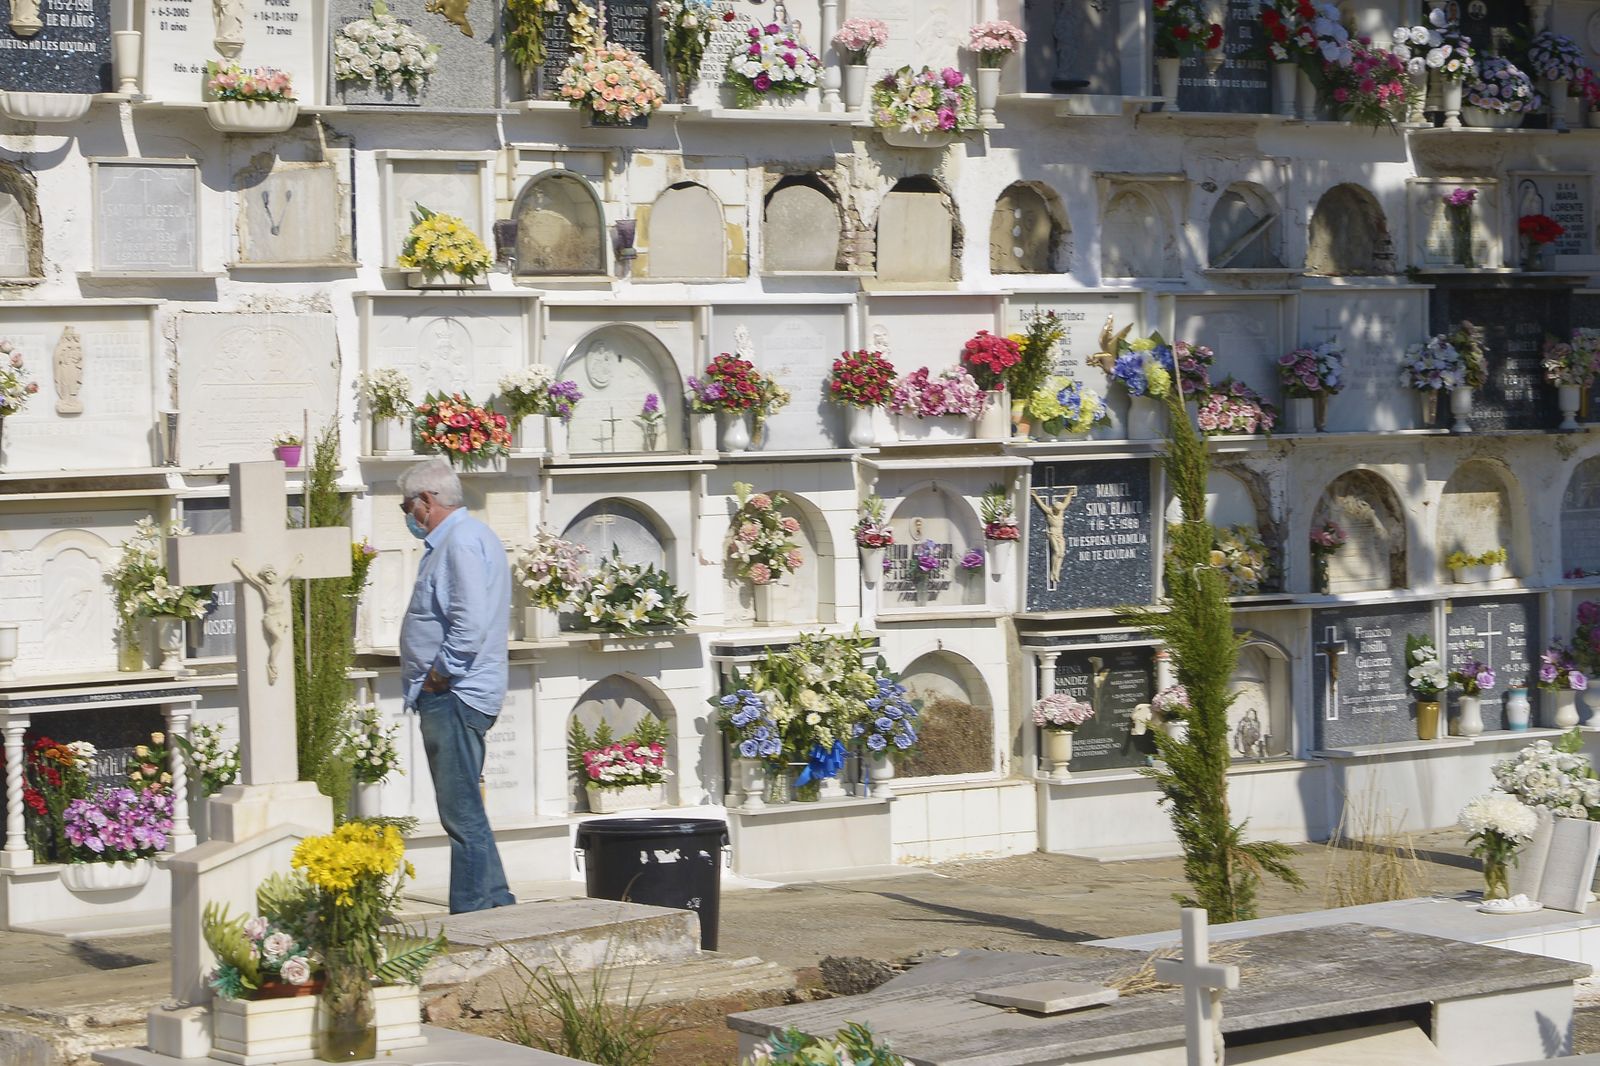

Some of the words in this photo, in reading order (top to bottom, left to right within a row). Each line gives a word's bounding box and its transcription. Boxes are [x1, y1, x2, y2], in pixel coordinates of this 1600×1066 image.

[46, 13, 59, 27] DE
[71, 12, 95, 28] AÑOS
[612, 17, 645, 29] GOMEZ
[170, 23, 187, 32] años
[29, 40, 40, 50] NO
[41, 41, 59, 51] LES
[60, 41, 97, 52] OLVIDAN
[190, 64, 199, 74] de
[1552, 203, 1584, 212] LORENTE
[1096, 483, 1130, 497] MANUEL
[1110, 501, 1143, 515] BLANCO
[1068, 537, 1079, 547] TU
[1080, 535, 1111, 547] ESPOSA
[1117, 534, 1147, 545] FAMILIA
[1079, 551, 1091, 561] NO
[1092, 550, 1103, 560] TE
[1103, 548, 1137, 560] OLVIDAN
[1355, 625, 1393, 638] Francisco
[1360, 641, 1388, 653] Rosillo
